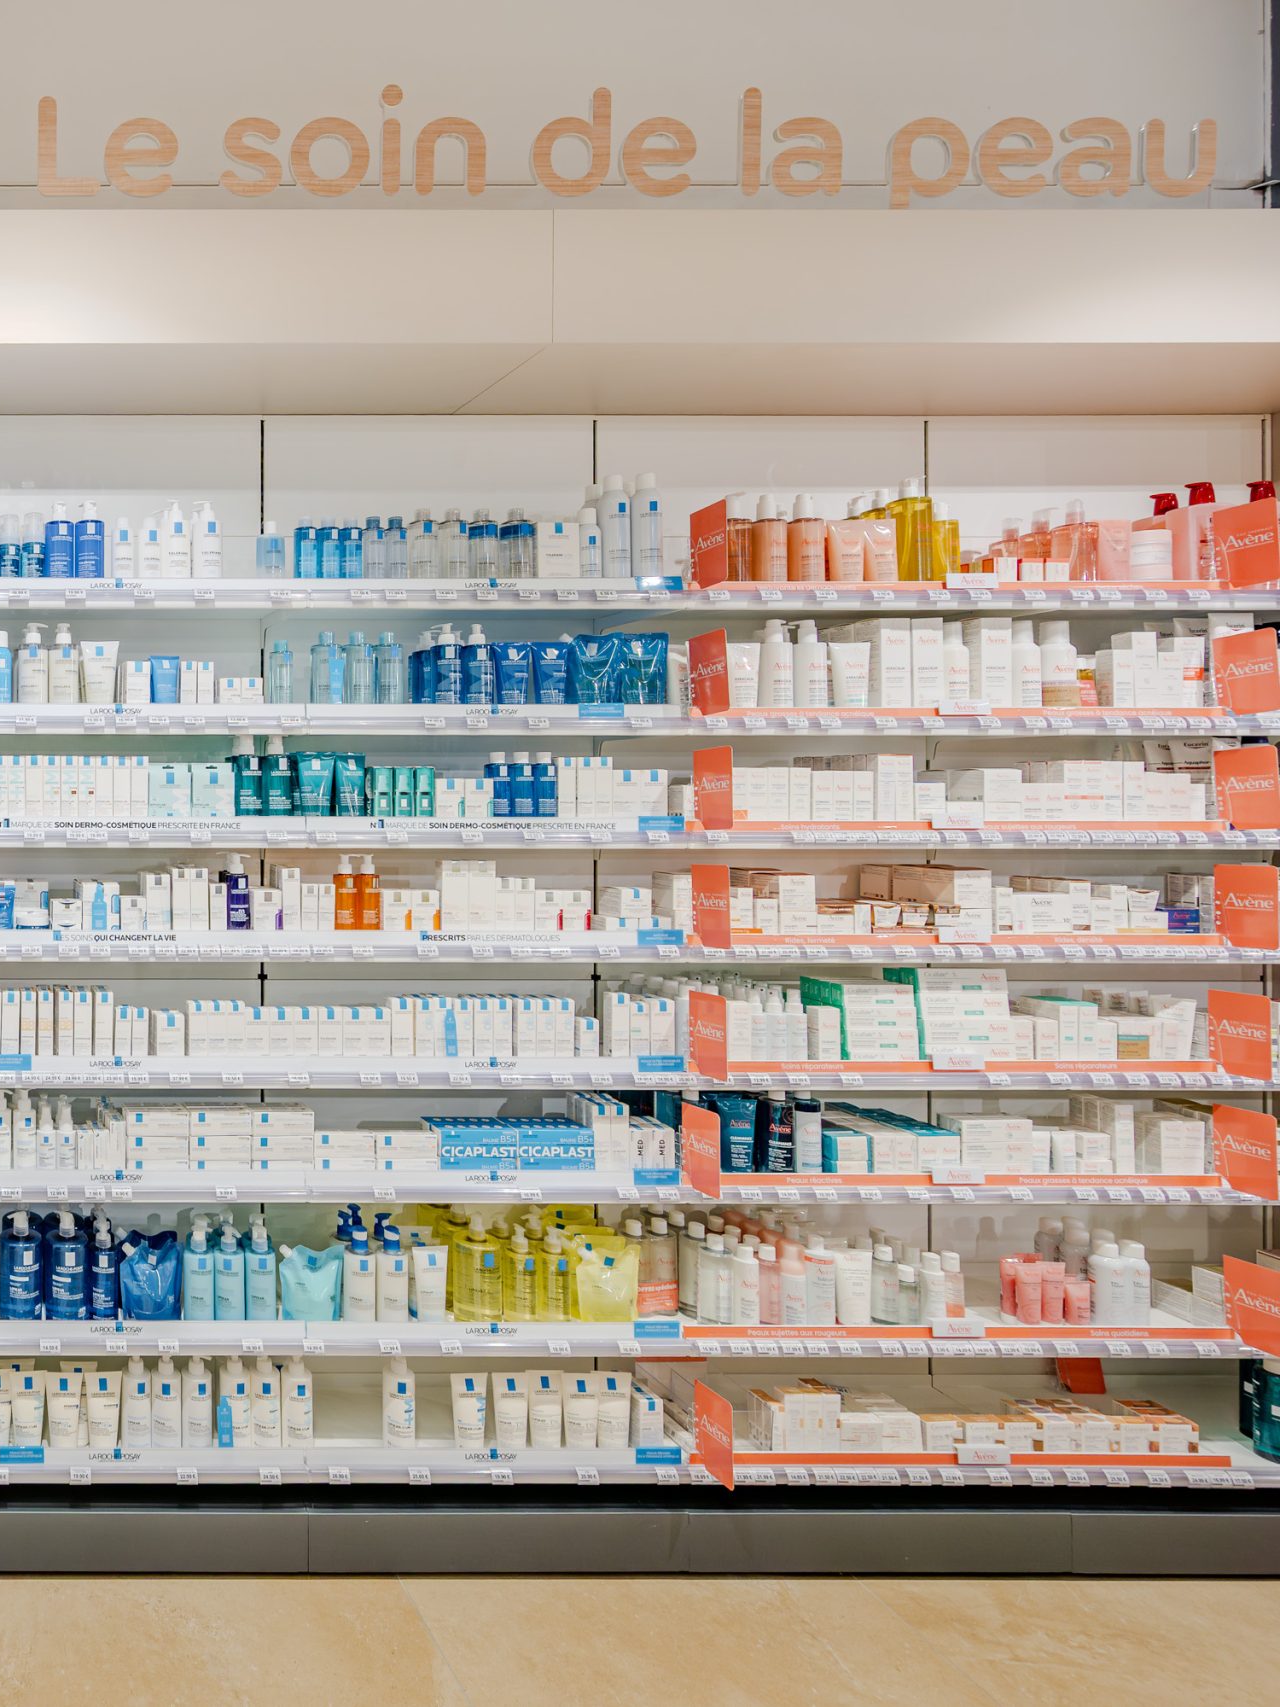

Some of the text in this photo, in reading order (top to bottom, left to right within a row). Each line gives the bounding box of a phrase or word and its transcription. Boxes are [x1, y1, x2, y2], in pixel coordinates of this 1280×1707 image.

[38, 84, 1217, 209] Le soin de la peau
[696, 532, 725, 551] Avène
[1224, 530, 1274, 549] Avène
[696, 661, 725, 677] Avène
[1225, 661, 1274, 677] Avène
[699, 776, 730, 792] Avène
[1225, 776, 1275, 792] Avène
[75, 821, 157, 829] DERMO-COSMÉTIQUE
[450, 822, 532, 830] DERMO-COSMÉTIQUE
[698, 893, 728, 909] Avène
[1224, 893, 1275, 910] Avène
[694, 1020, 724, 1040] Avène
[1219, 1019, 1267, 1040] Avène
[441, 1145, 517, 1159] CICAPLAST
[519, 1145, 595, 1159] CICAPLAST
[687, 1134, 718, 1158] Avène
[1223, 1135, 1272, 1157] Avène
[1234, 1289, 1280, 1316] Avène
[700, 1414, 731, 1446] Avène
